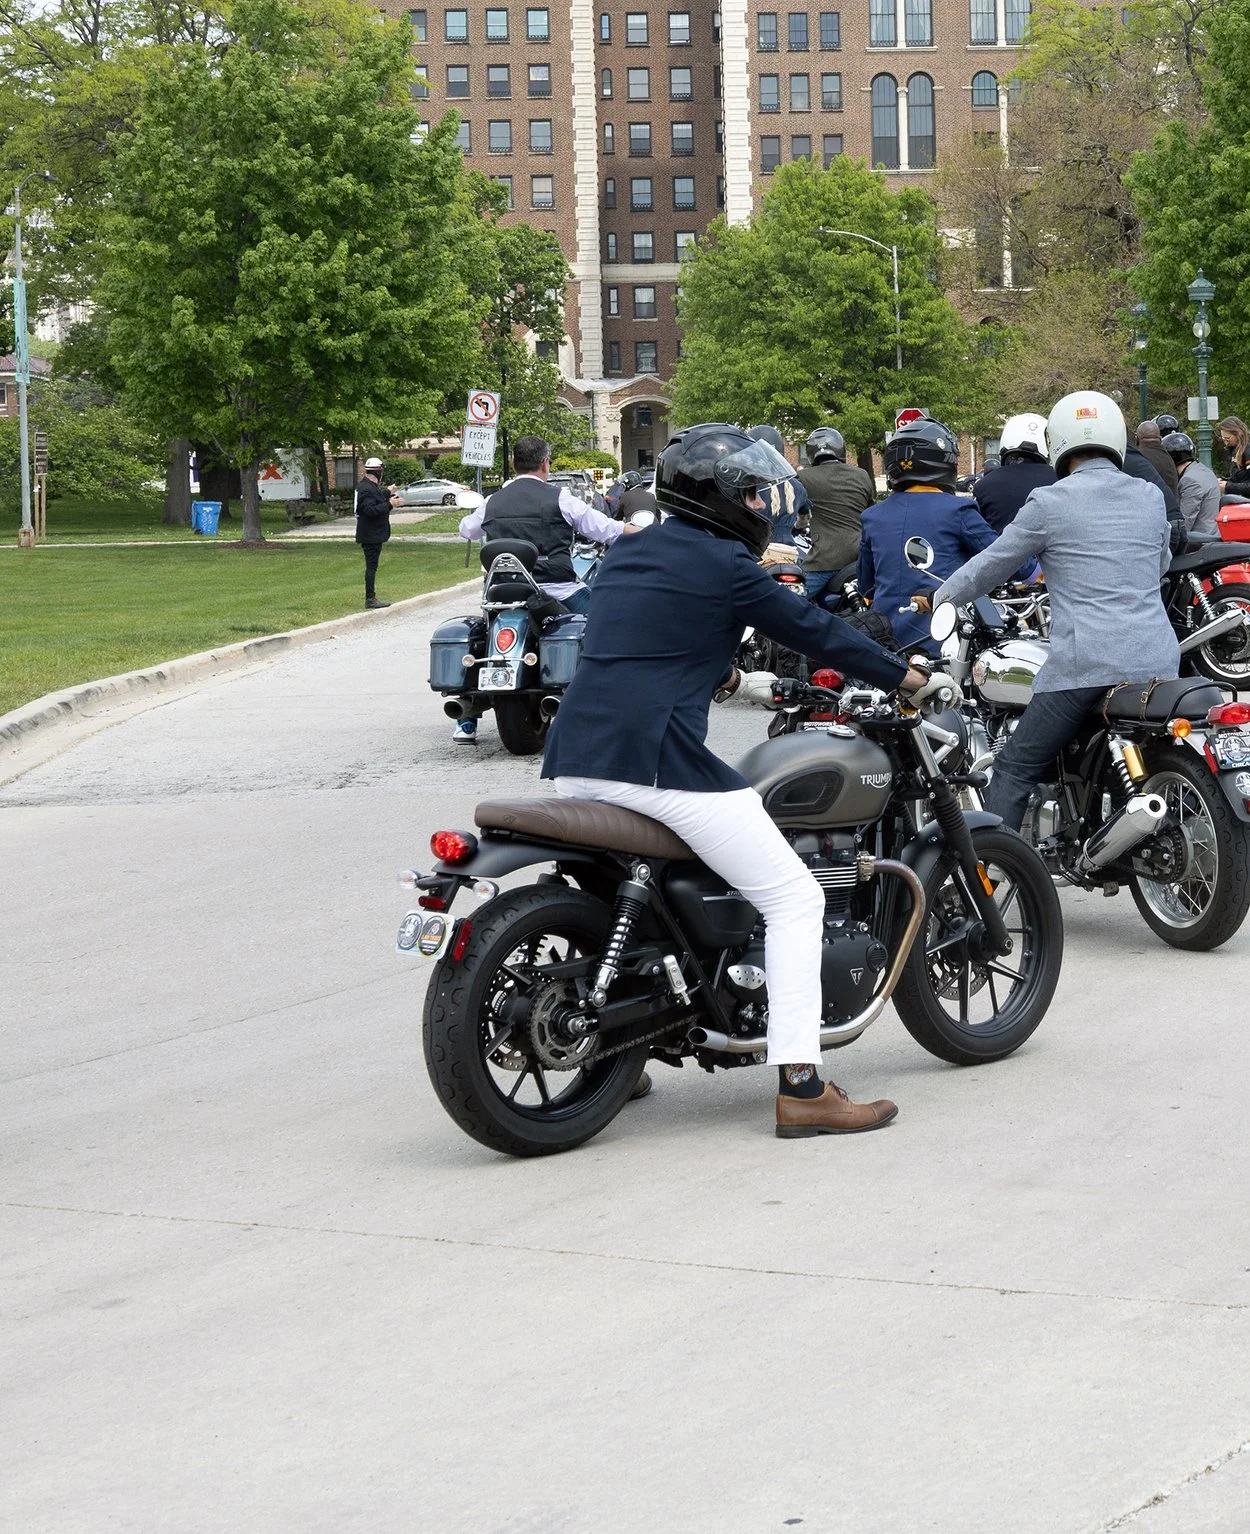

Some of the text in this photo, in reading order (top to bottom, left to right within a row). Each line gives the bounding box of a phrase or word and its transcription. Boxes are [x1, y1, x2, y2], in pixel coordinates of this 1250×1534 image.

[469, 431, 490, 440] EXCEPT
[473, 442, 484, 450] CTA
[465, 452, 491, 461] VEHICLES
